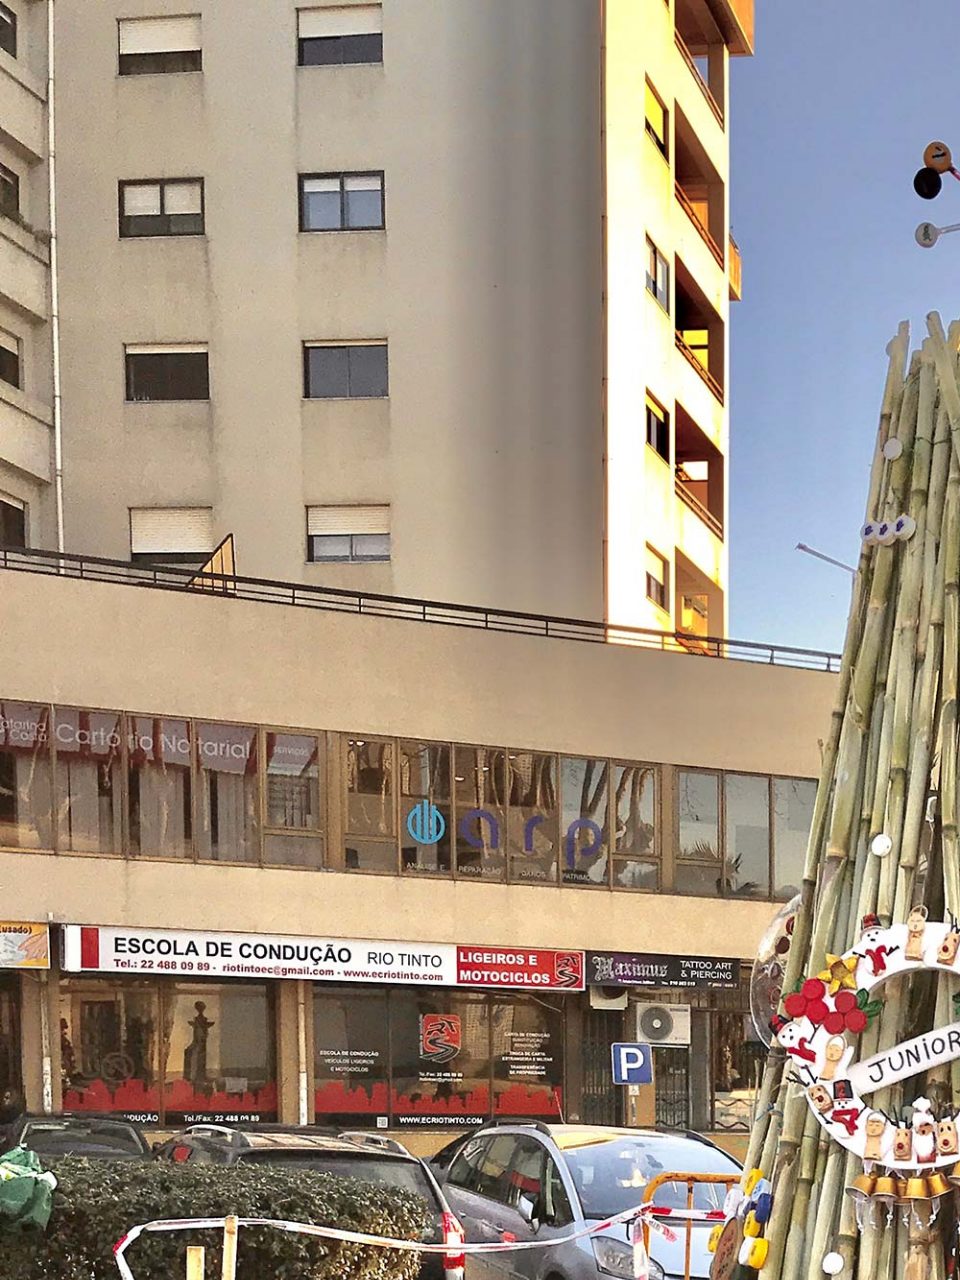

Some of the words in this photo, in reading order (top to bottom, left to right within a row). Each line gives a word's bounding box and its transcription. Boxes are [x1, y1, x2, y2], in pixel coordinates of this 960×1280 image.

[161, 733, 249, 759] Notarial
[114, 937, 199, 957] ESCOLA
[206, 941, 232, 958] DE
[239, 943, 352, 965] CONDUÇÃO
[367, 952, 394, 966] RIO
[398, 953, 442, 968] TINTO
[460, 952, 525, 966] LIGEIROS
[529, 955, 537, 966] E
[114, 959, 137, 968] Tel.:
[140, 960, 154, 969] 22
[157, 961, 177, 970] 488
[180, 962, 194, 971] 09
[197, 963, 210, 971] 89
[222, 963, 334, 976] riotintoec@gmail.com
[343, 970, 443, 982] www.ecriotinto.com
[680, 960, 712, 970] TATTOO
[714, 962, 732, 970] ART
[460, 970, 550, 984] MOTOCICLOS
[680, 969, 688, 978] &
[690, 970, 732, 980] PIERCING
[620, 1047, 644, 1080] P
[399, 1116, 483, 1124] WWW.ECRIOTINTO.COM
